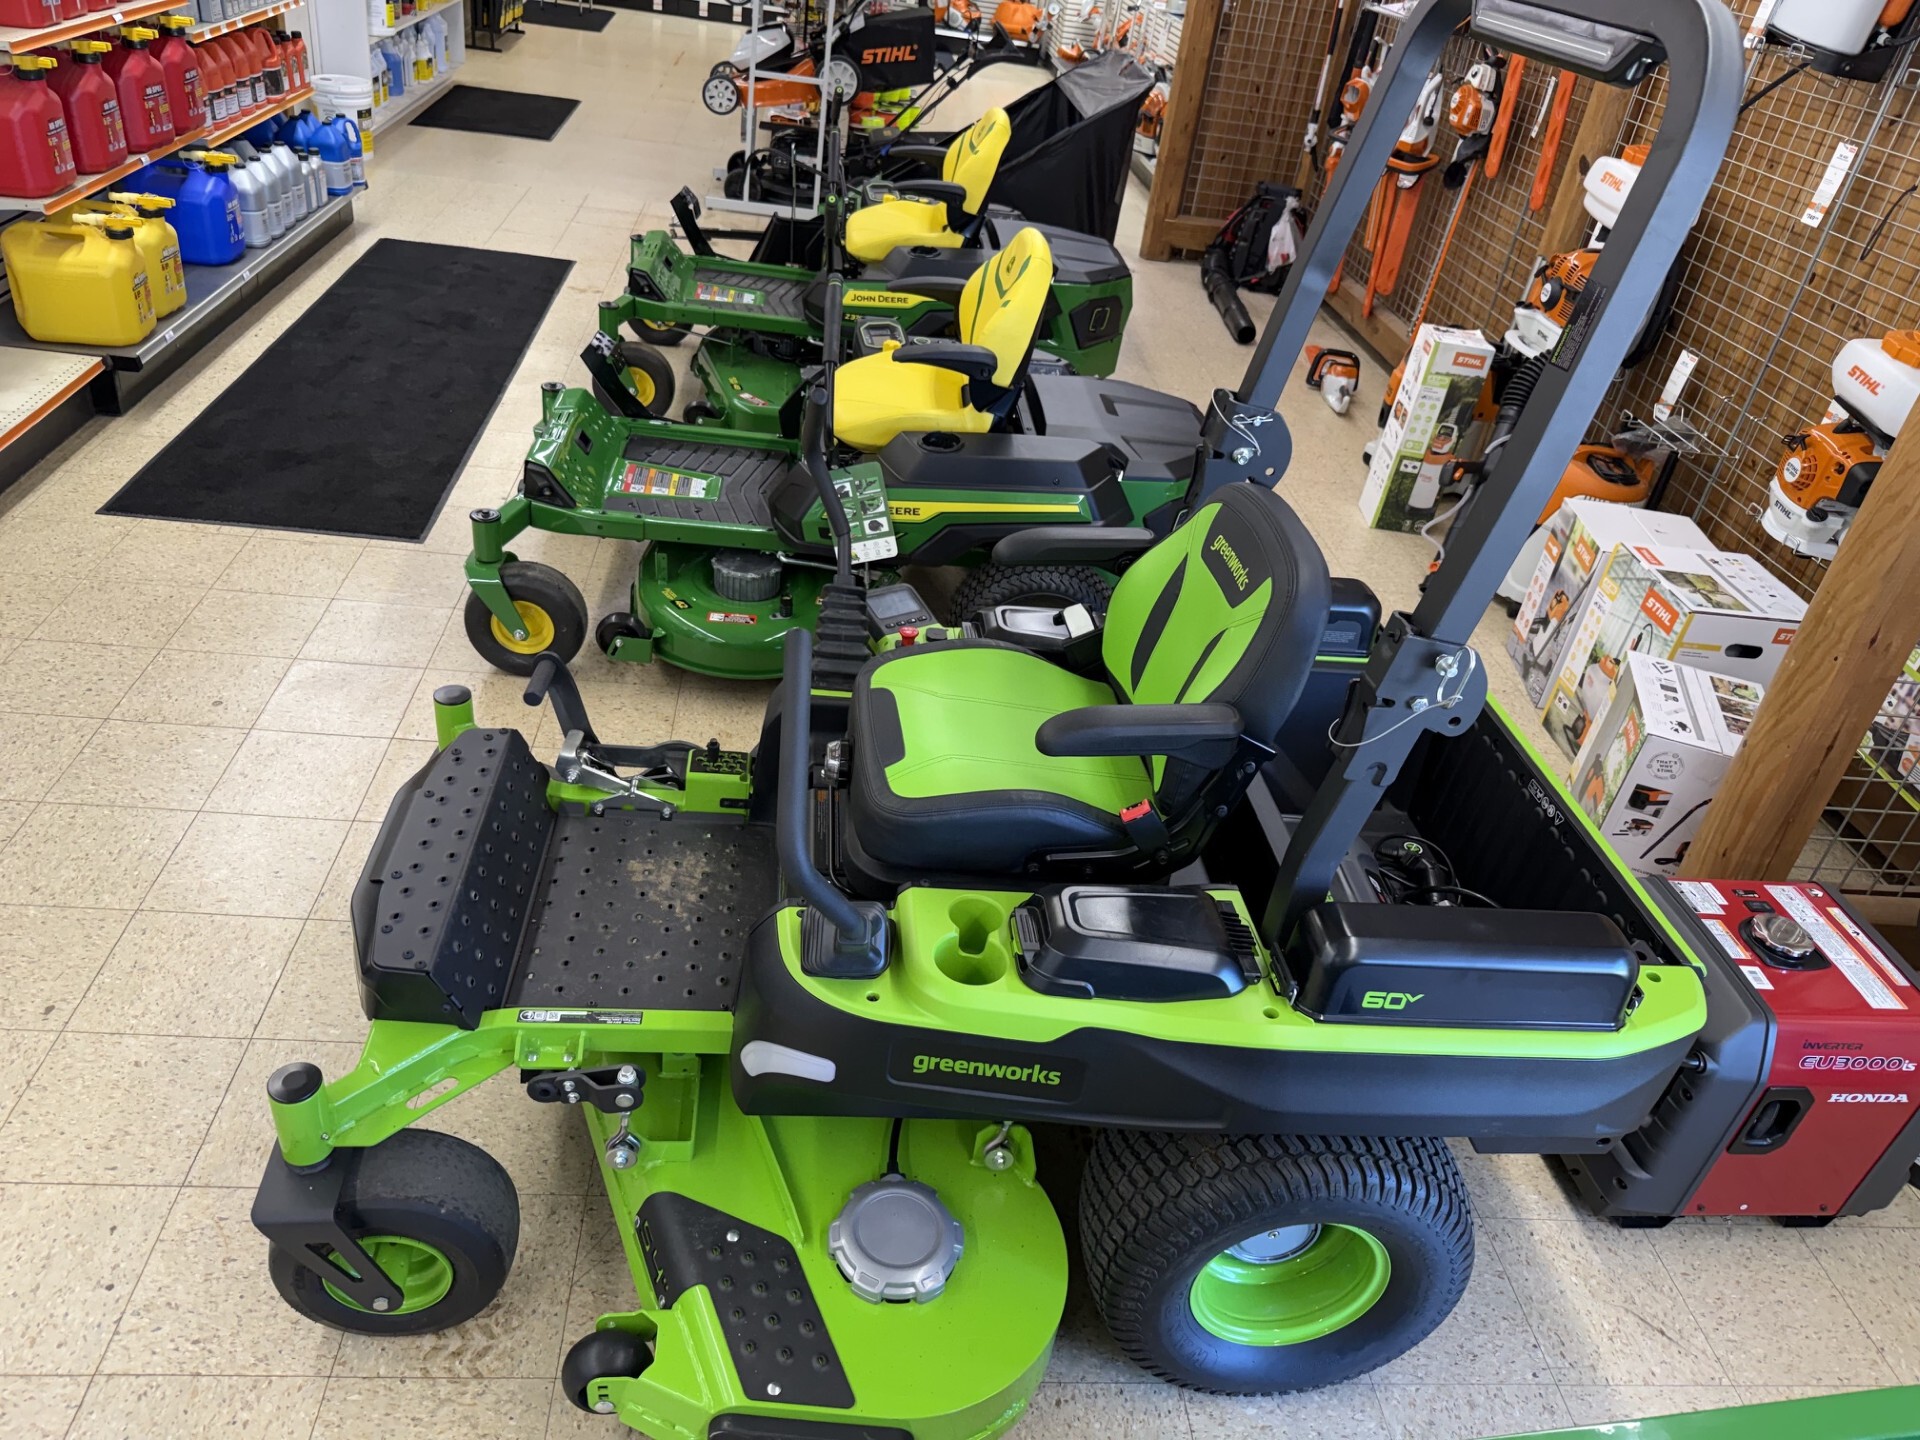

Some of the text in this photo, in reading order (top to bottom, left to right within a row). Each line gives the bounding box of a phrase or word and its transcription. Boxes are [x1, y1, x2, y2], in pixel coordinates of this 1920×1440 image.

[861, 45, 916, 65] STIHL
[1601, 171, 1624, 192] STIHL
[851, 294, 909, 304] JOHN DEERE
[1456, 356, 1482, 367] STIHL
[1847, 364, 1881, 396] STIHL
[888, 506, 921, 516] EERE
[1774, 500, 1792, 520] STIHL
[1210, 534, 1249, 592] greenworks
[1576, 541, 1591, 567] STIHL
[1645, 596, 1672, 627] STIHL
[1361, 990, 1425, 1010] 60V
[912, 1054, 1062, 1086] greenworks
[1799, 1055, 1917, 1071] EU3000is
[1827, 1093, 1909, 1103] HONDA
